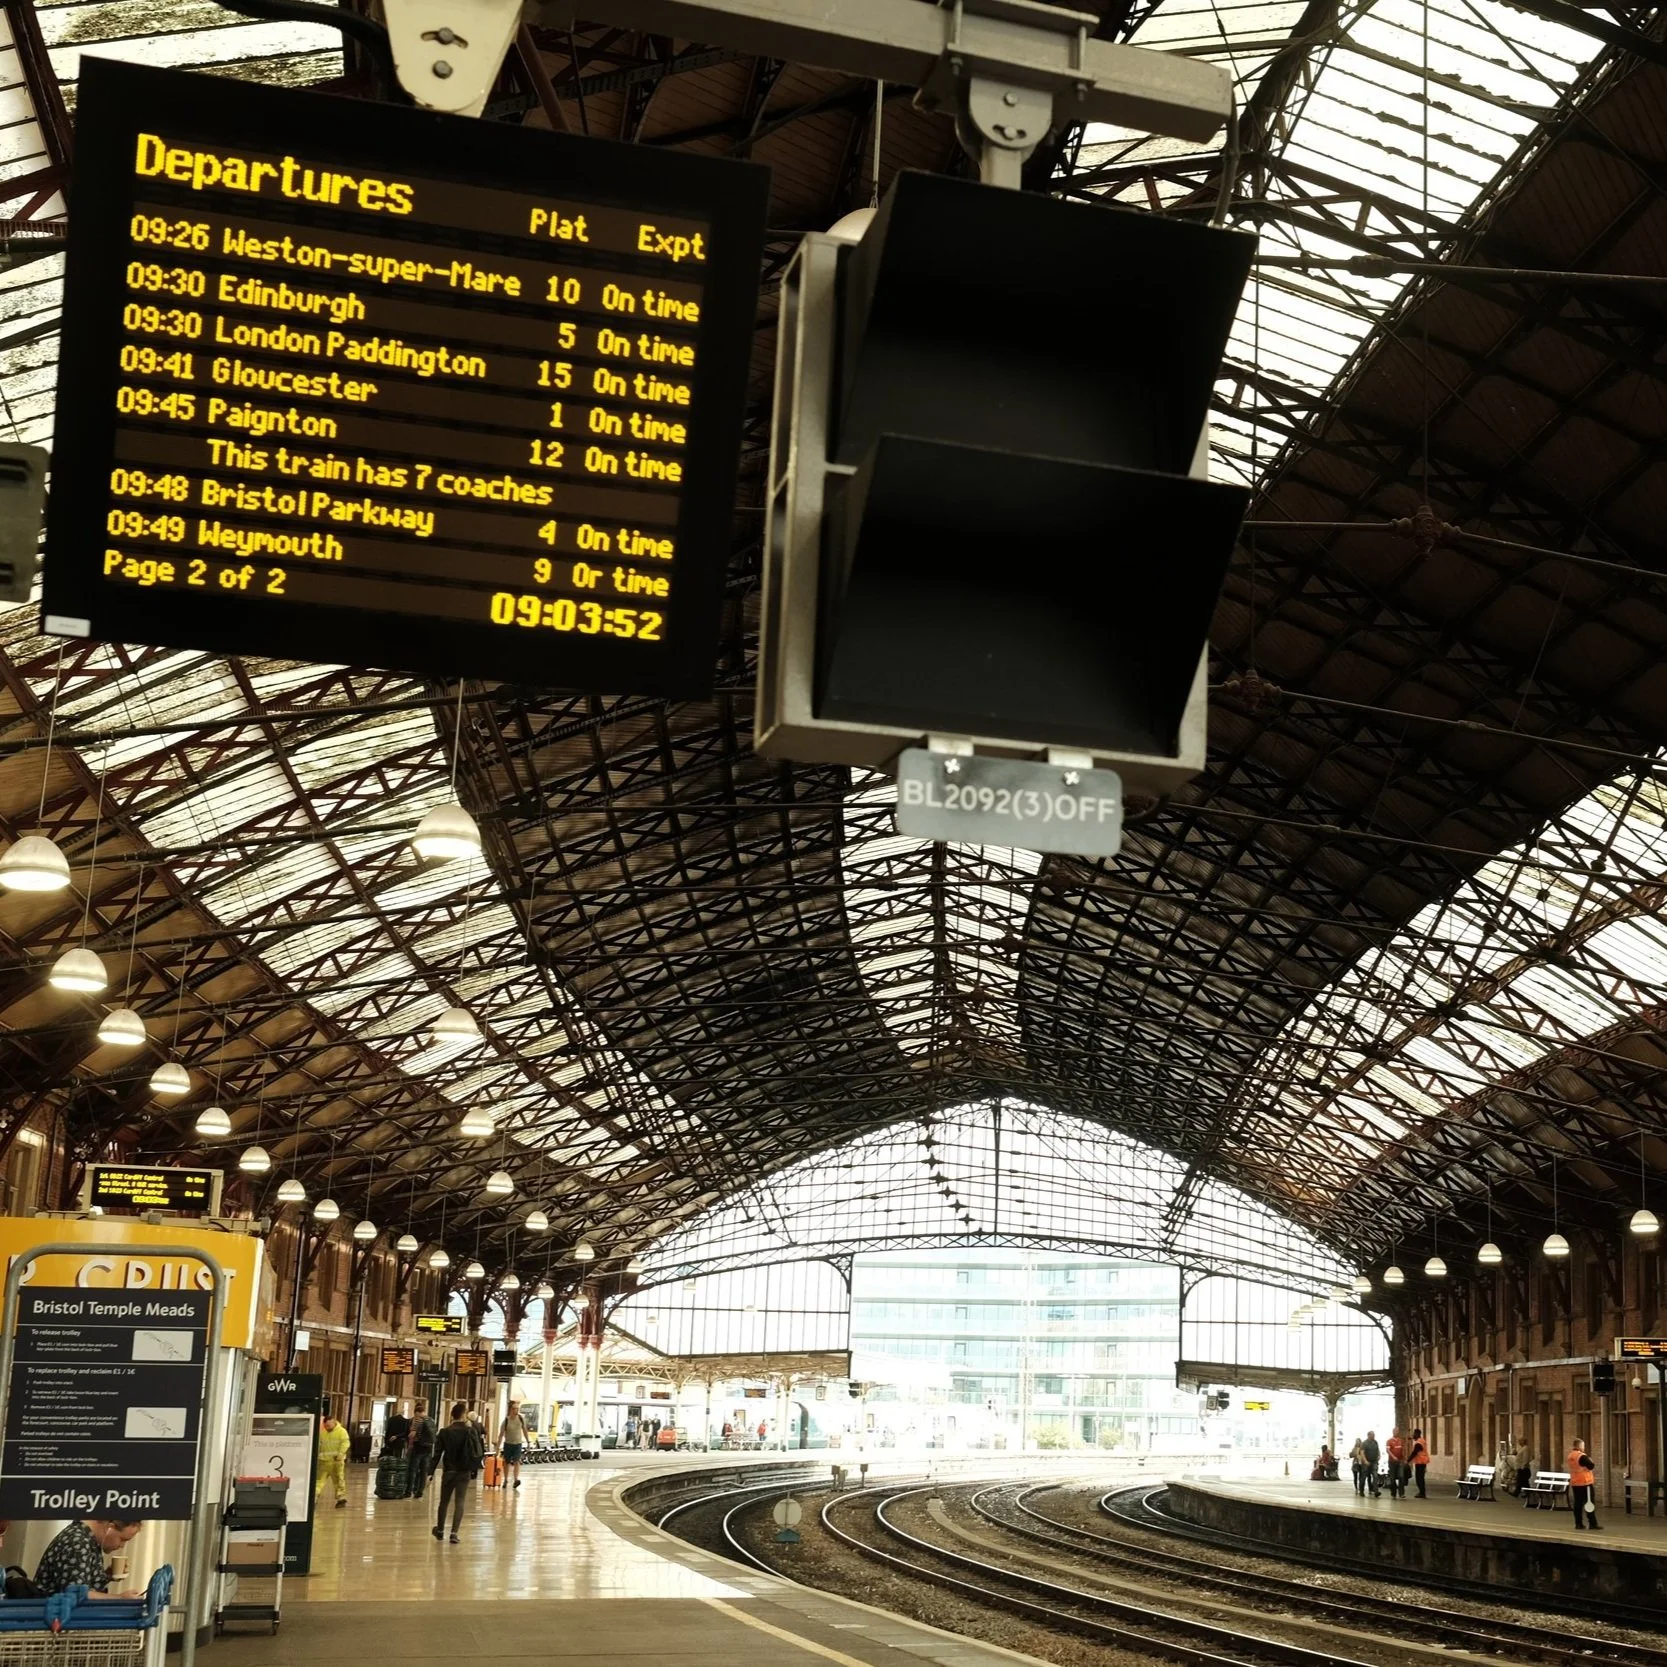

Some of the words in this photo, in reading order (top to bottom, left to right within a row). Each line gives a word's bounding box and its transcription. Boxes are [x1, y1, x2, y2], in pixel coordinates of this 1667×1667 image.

[136, 133, 414, 214] Departures
[131, 215, 210, 250] 09:26
[223, 228, 521, 296] Weston-super-Mare
[546, 276, 581, 304] 10
[602, 284, 635, 313] On
[642, 290, 699, 322] time
[530, 208, 589, 242] Plat
[638, 225, 705, 262] Expt
[127, 262, 205, 297] 09:30
[218, 274, 365, 323] Edinburgh
[558, 323, 576, 349] 5
[597, 329, 631, 357] On
[637, 334, 694, 366] time
[123, 304, 202, 338] 09:30
[215, 316, 320, 355] London
[326, 331, 486, 377] Paddington
[537, 360, 572, 388] 15
[593, 368, 627, 396] On
[633, 373, 690, 405] time
[120, 345, 194, 379] 09:41
[212, 357, 378, 402] Gloucester
[550, 402, 563, 428] 1
[589, 407, 623, 435] On
[629, 412, 686, 444] time
[117, 386, 196, 420] 09:45
[208, 398, 337, 438] Paignton
[529, 439, 564, 467] 12
[585, 446, 618, 474] On
[624, 451, 682, 482] time
[207, 439, 269, 470] This
[275, 448, 350, 481] train
[356, 457, 408, 487] has
[415, 464, 432, 490] 7
[436, 474, 553, 505] coaches
[111, 469, 189, 501] 09:48
[201, 479, 307, 516] Bristol
[311, 492, 434, 537] Parkway
[538, 520, 557, 545] 4
[577, 524, 611, 551] On
[616, 528, 674, 559] time
[104, 550, 175, 586] Page
[188, 559, 207, 585] 2
[219, 565, 255, 589] of
[267, 568, 286, 594] 2
[107, 510, 185, 542] 09:49
[198, 520, 343, 560] Weymouth
[533, 558, 552, 583] 9
[612, 567, 669, 597] time
[490, 592, 662, 640] 09:03:52
[903, 779, 1116, 823] BL2092(3)OFF
[33, 1300, 84, 1315] Bristol
[87, 1301, 142, 1318] Temple
[145, 1302, 195, 1317] Meads
[267, 1378, 297, 1393] GWR
[30, 1489, 100, 1512] Trolley
[105, 1490, 161, 1509] Point
